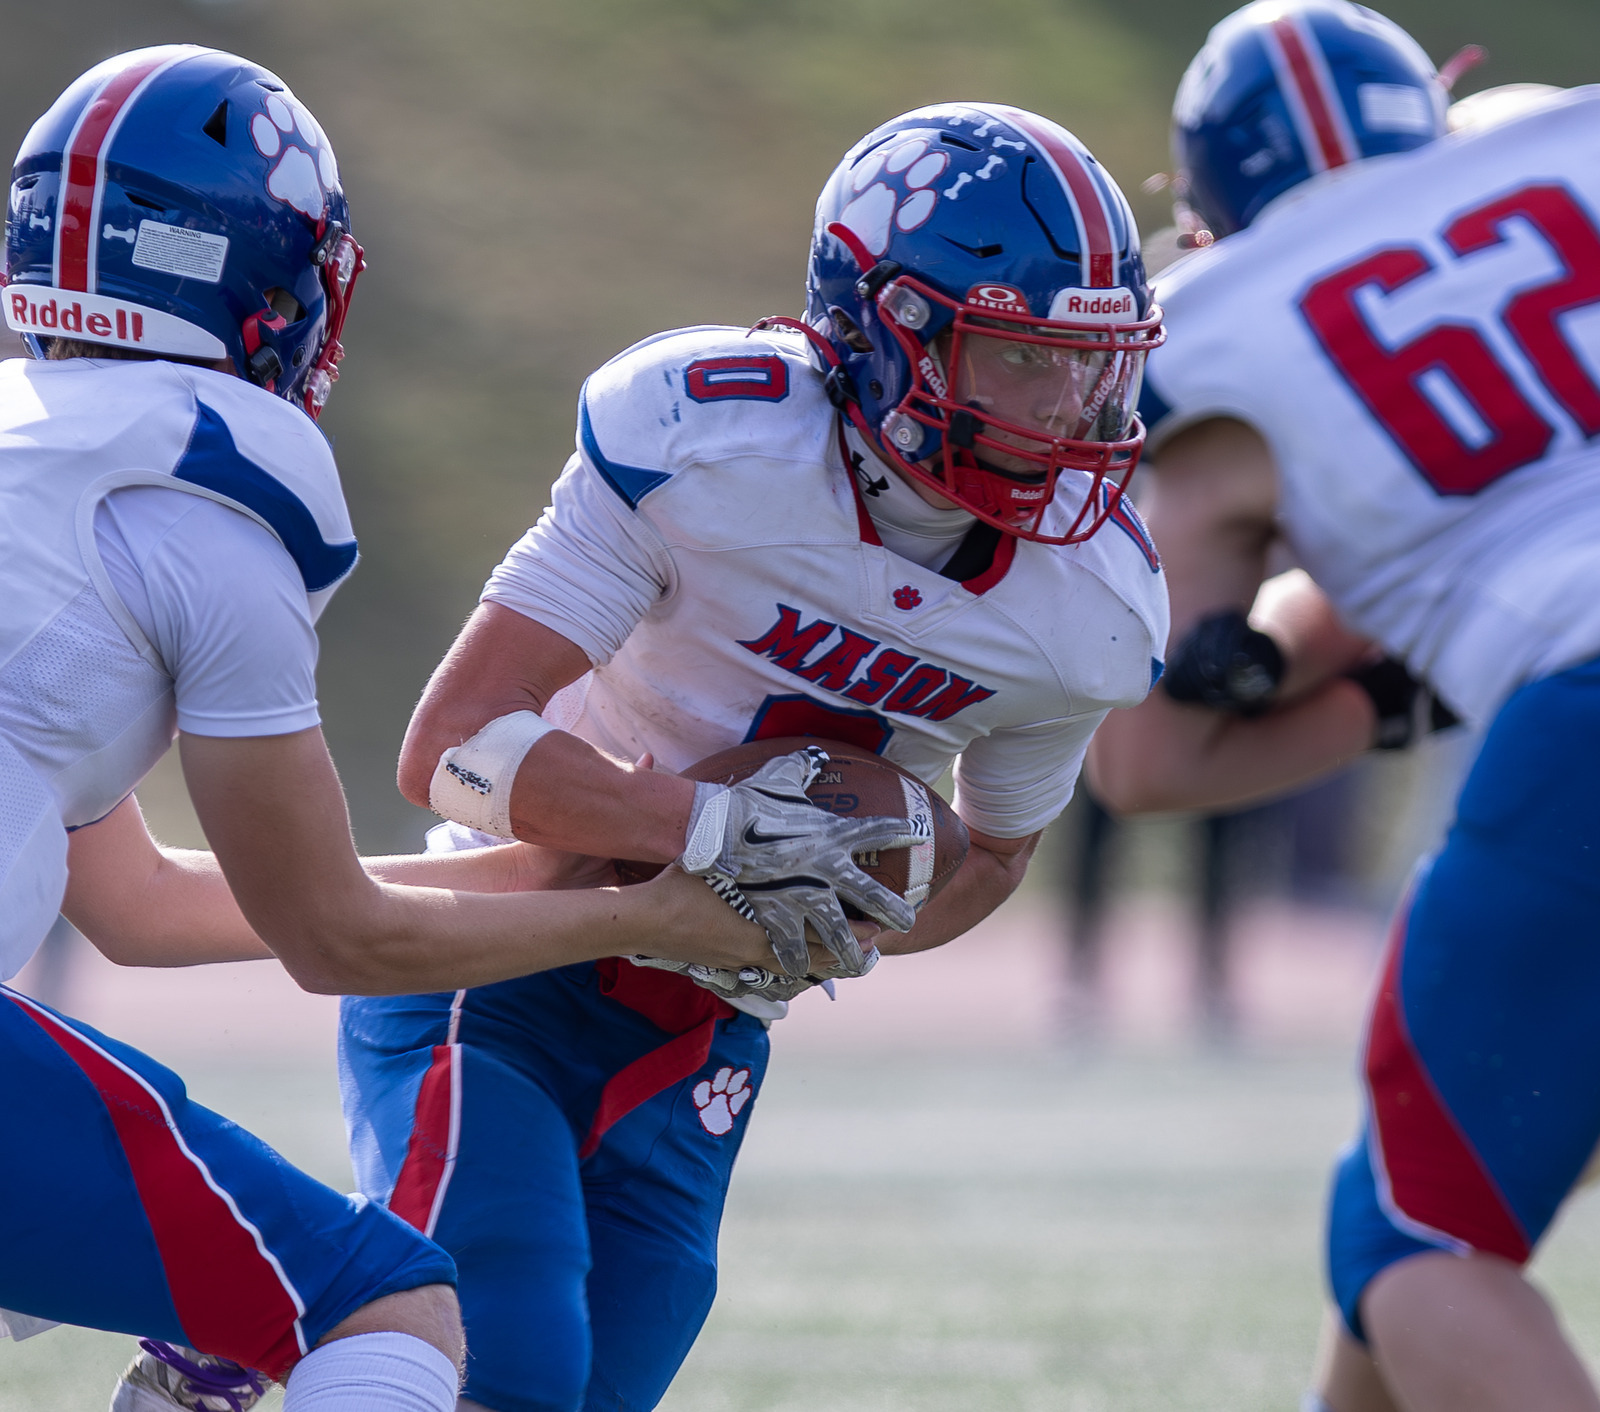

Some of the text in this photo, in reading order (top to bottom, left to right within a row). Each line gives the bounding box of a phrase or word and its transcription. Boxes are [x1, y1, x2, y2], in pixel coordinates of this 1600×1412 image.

[169, 226, 202, 239] WARNING
[10, 293, 144, 342] Riddell
[968, 297, 1025, 312] OAKLEY
[1068, 294, 1131, 314] Riddell
[1297, 180, 1600, 496] 62
[735, 602, 998, 722] MASON
